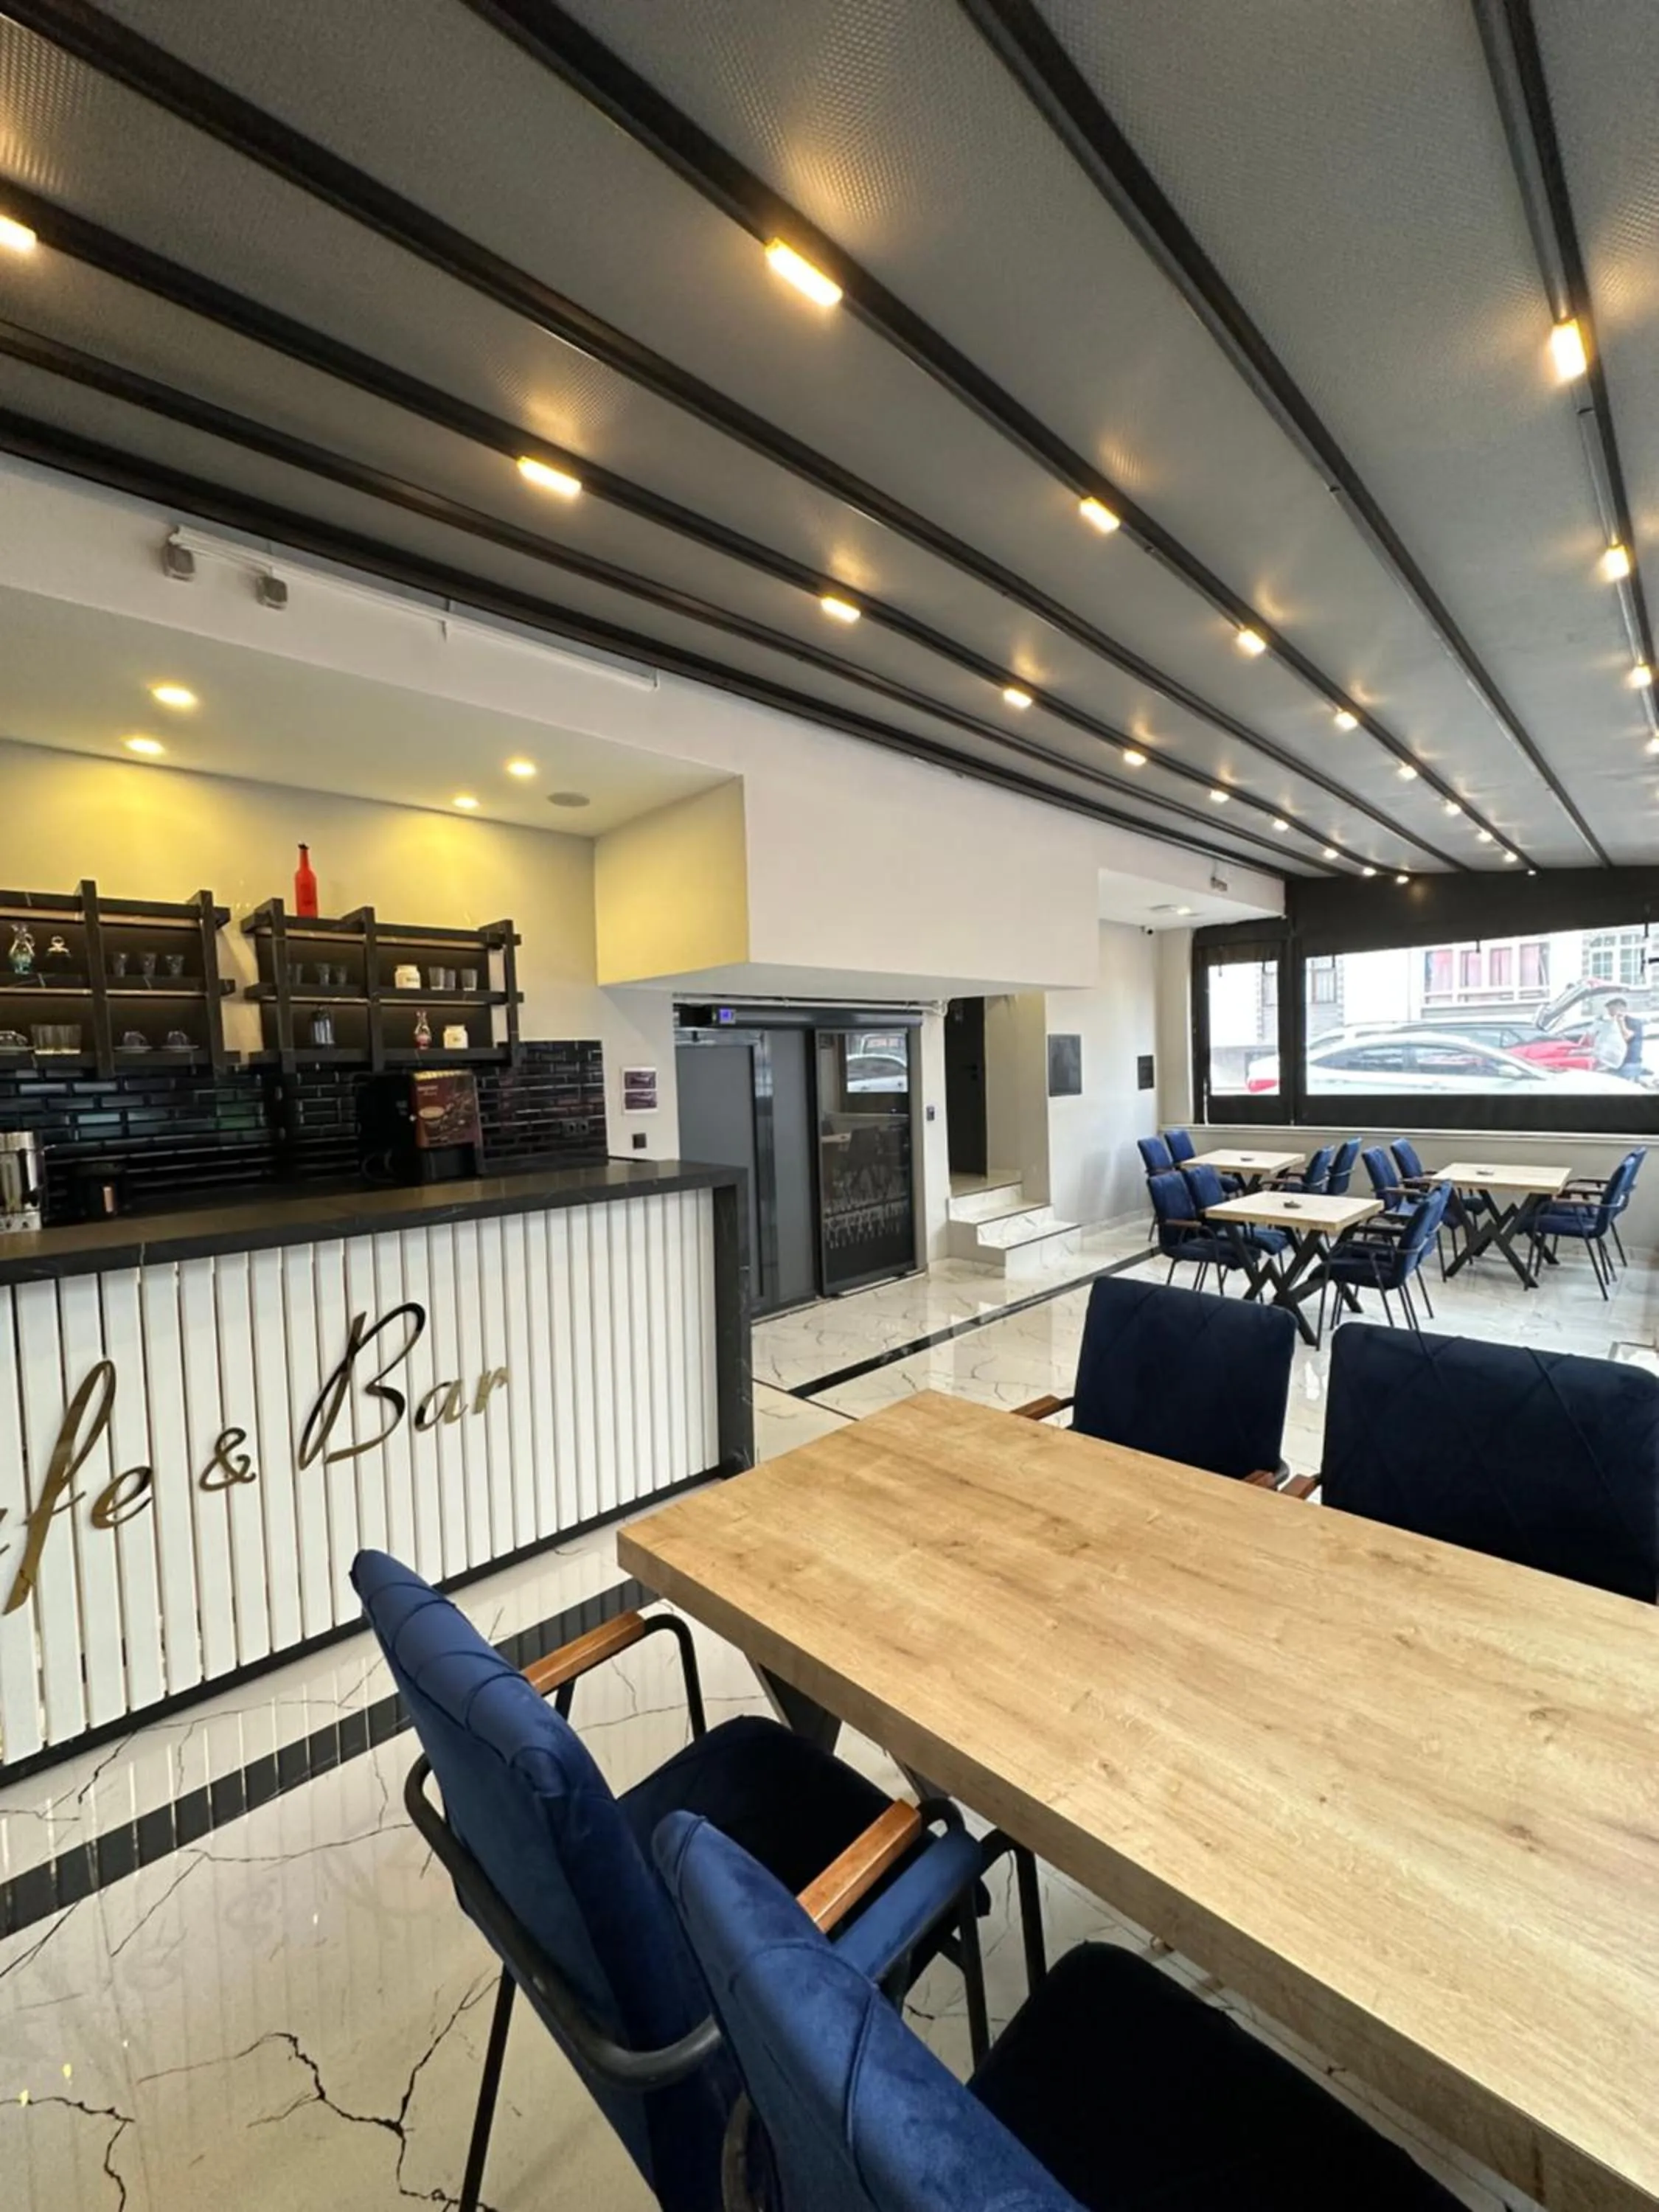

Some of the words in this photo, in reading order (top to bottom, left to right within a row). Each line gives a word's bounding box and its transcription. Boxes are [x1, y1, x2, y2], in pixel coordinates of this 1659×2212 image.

[0, 1359, 153, 1615] fe
[198, 1427, 257, 1492] &
[299, 1301, 508, 1470] Bar
